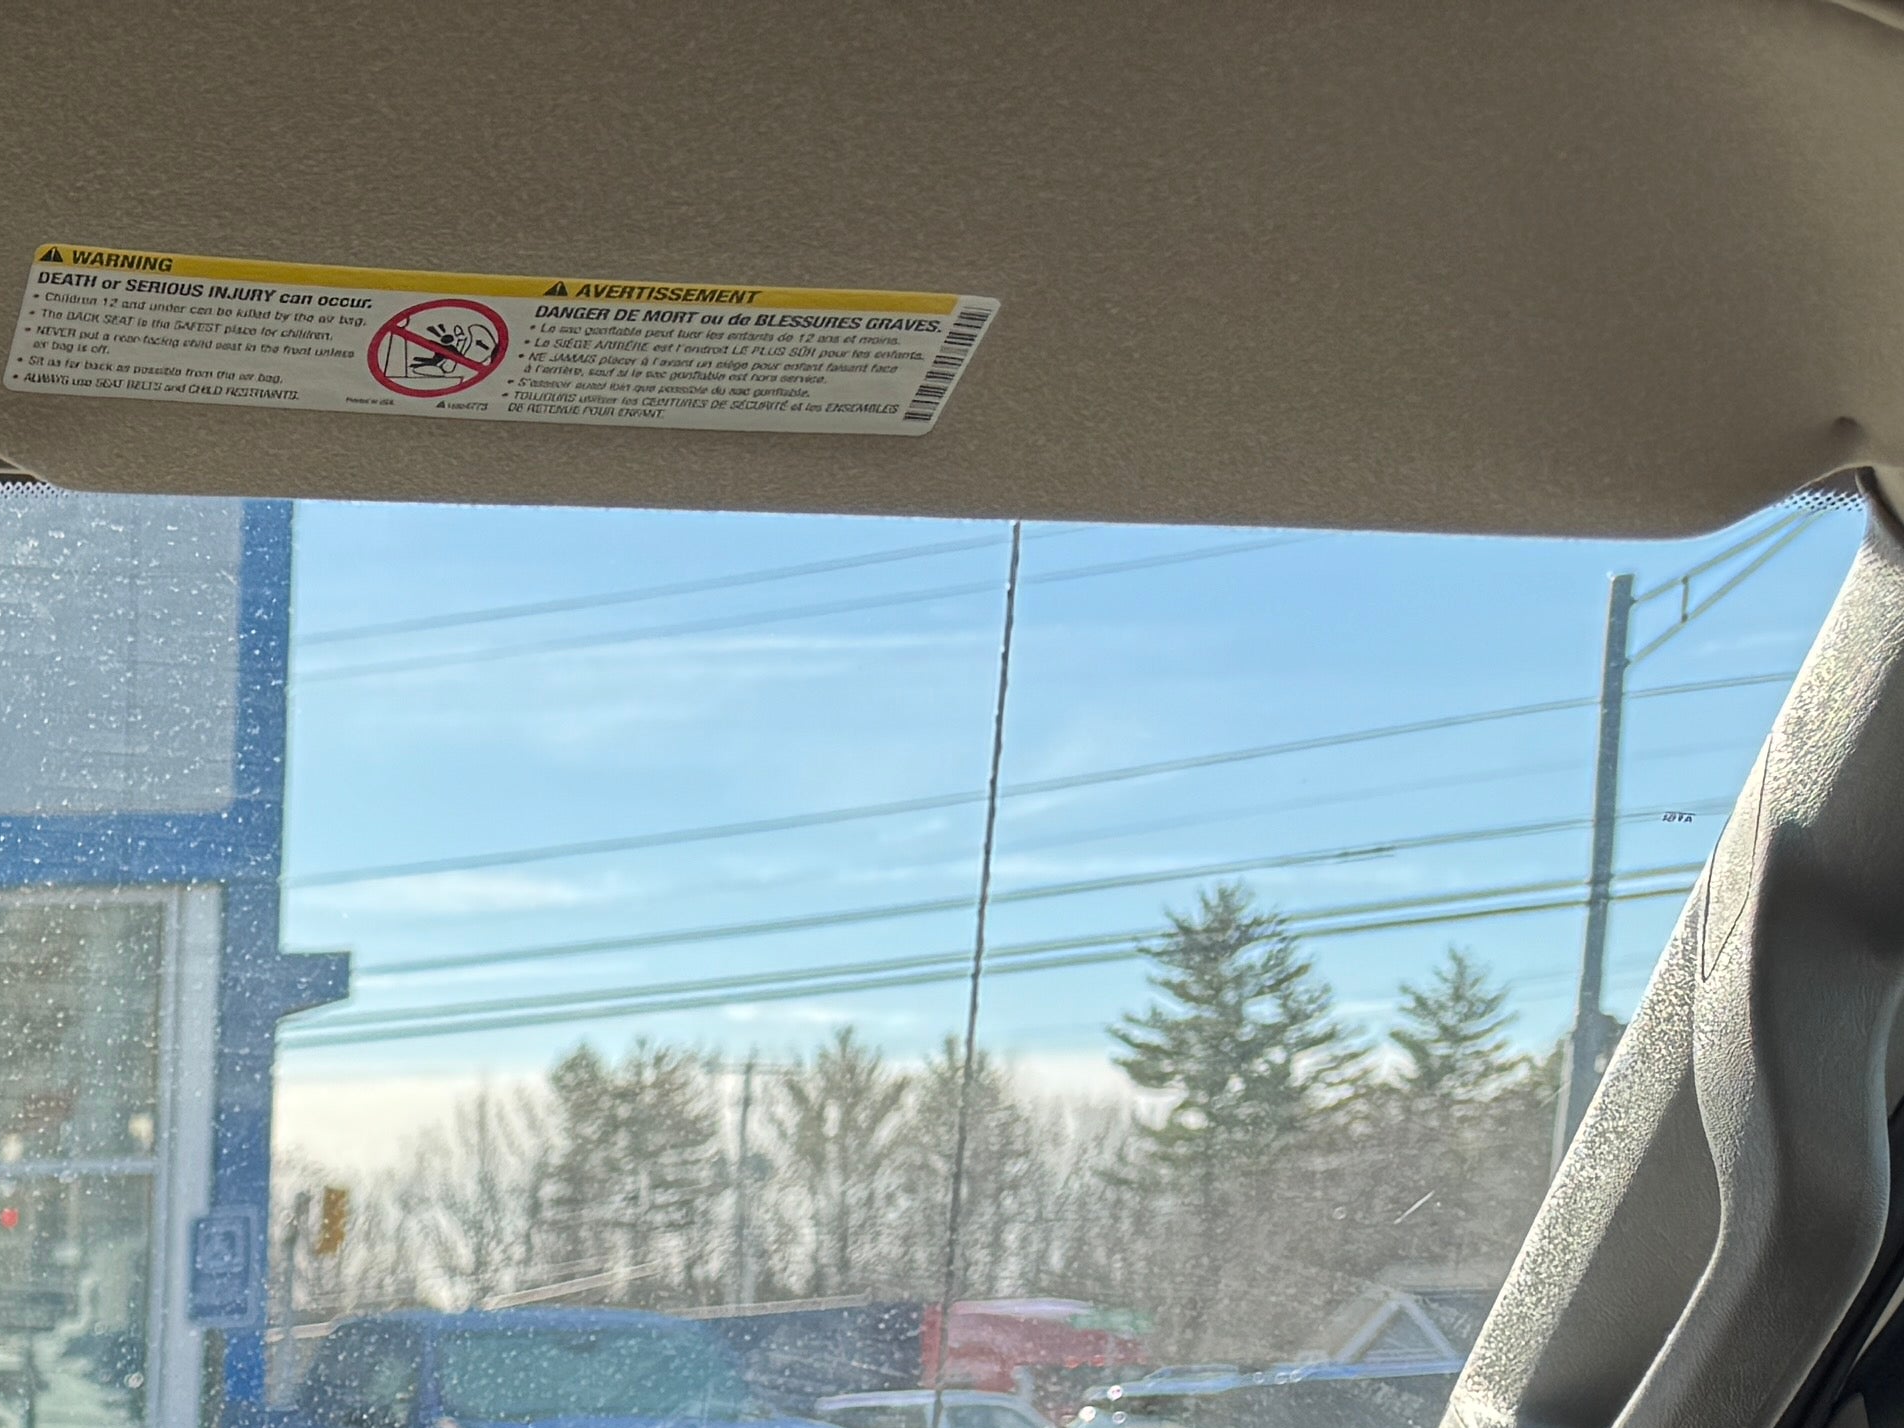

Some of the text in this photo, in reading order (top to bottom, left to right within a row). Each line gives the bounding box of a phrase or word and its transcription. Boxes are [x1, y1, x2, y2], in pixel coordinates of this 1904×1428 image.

[72, 250, 173, 272] WARNING
[38, 271, 372, 309] DEATH or SERIOUS INJURY can occur.
[576, 283, 762, 304] AVERTISSEMENT
[535, 305, 942, 333] DANGER DE MORT ou de BLESSURES GRAVES.
